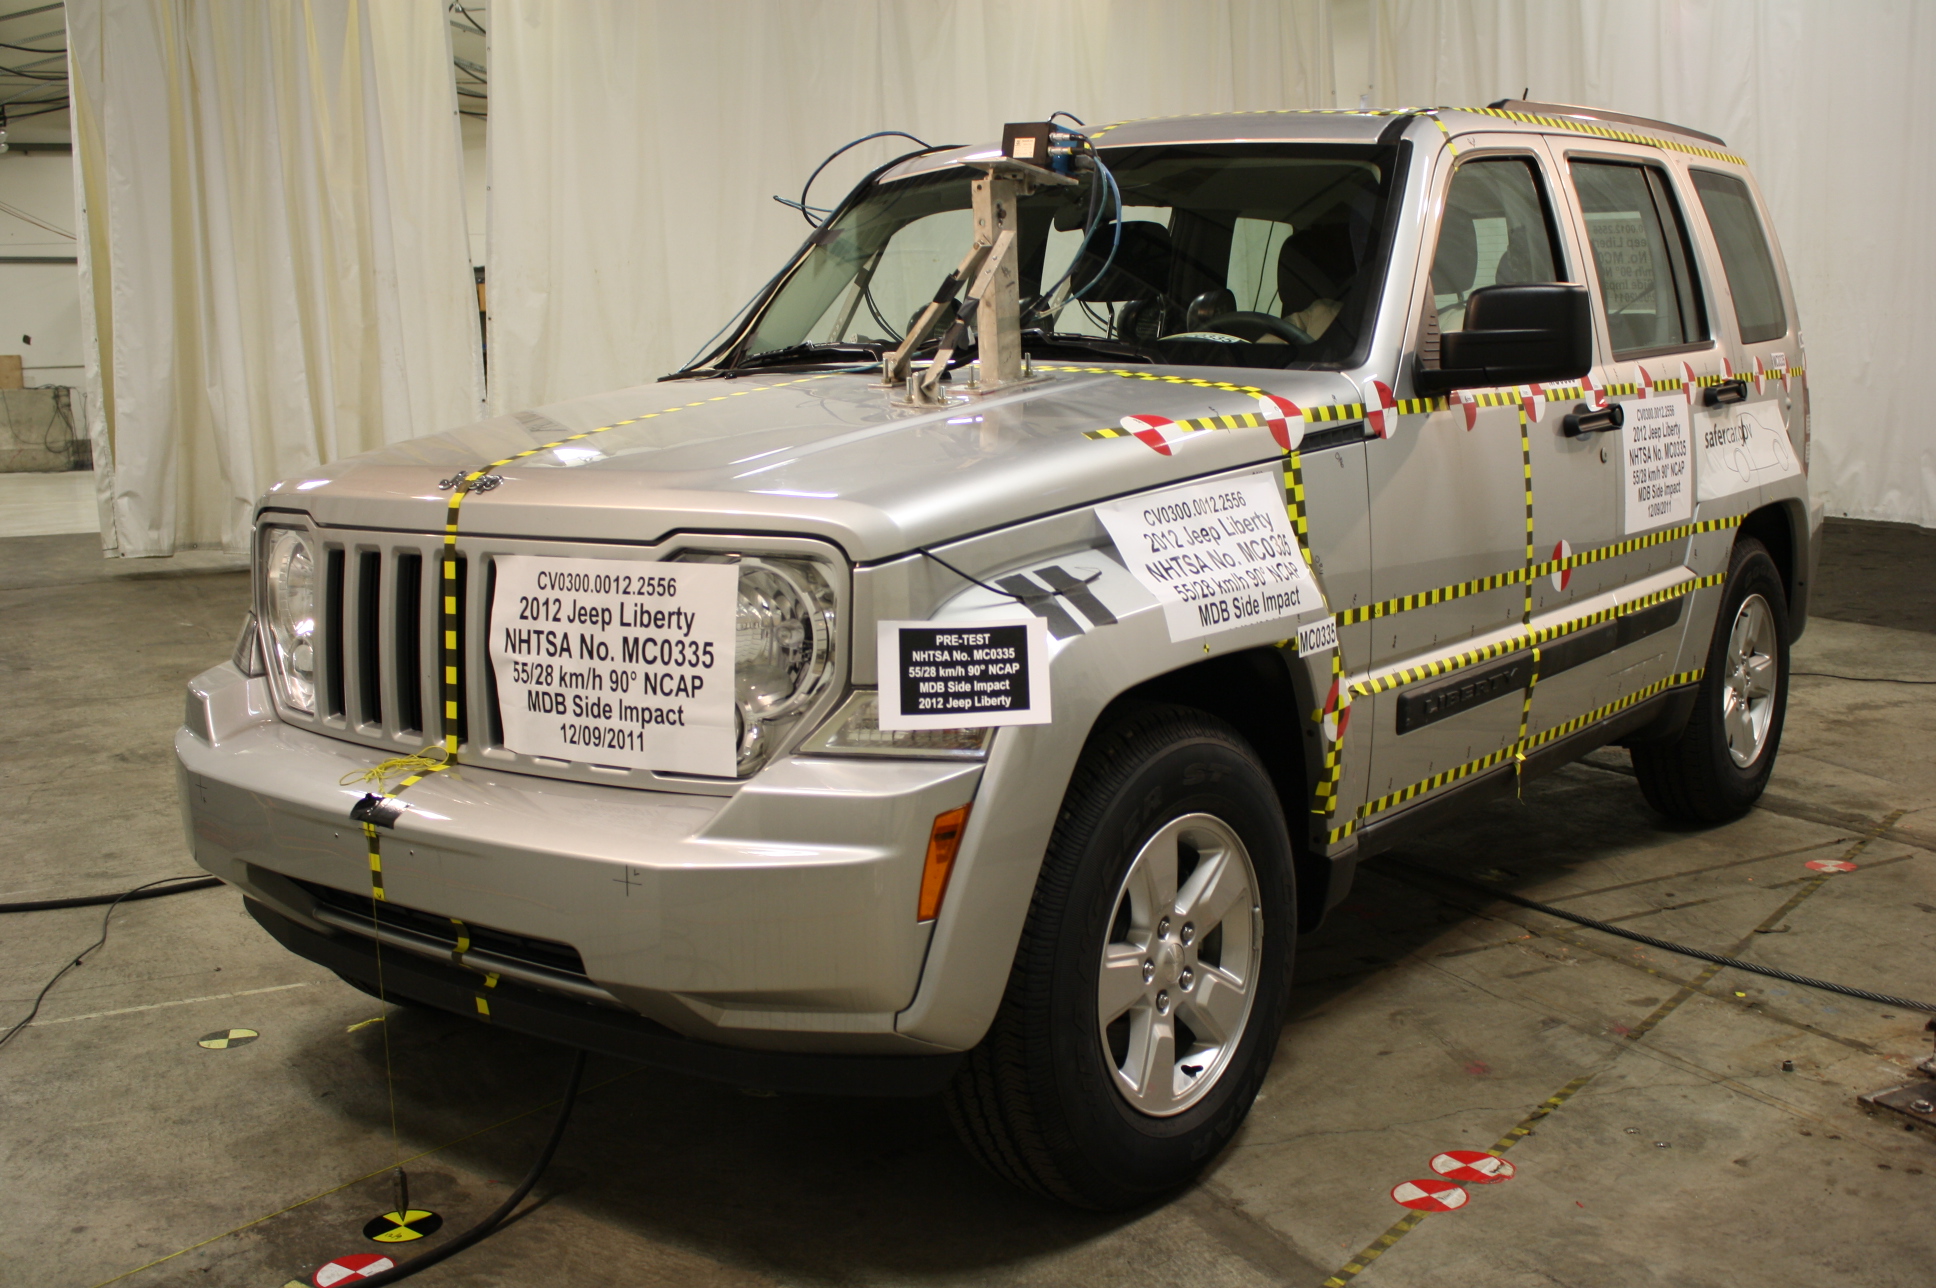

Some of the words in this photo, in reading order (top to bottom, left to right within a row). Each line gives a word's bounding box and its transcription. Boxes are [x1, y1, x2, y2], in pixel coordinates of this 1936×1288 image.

[1636, 404, 1675, 421] CV0300.0012.2556
[1632, 425, 1647, 443] 2012
[1648, 424, 1662, 440] Jeep
[1662, 422, 1681, 440] Liberty
[1629, 448, 1652, 467] NHTSA
[1653, 446, 1664, 462] No.
[1664, 440, 1687, 459] MC0335
[1632, 468, 1647, 485] 55/28
[1647, 465, 1661, 482] km/h
[1661, 463, 1669, 479] 90°
[1670, 460, 1685, 477] NCAP
[1637, 487, 1651, 503] MDB
[1651, 485, 1663, 500] Side
[1663, 481, 1681, 498] Impact
[1143, 490, 1247, 527] CV0300.0012.2556
[1647, 501, 1672, 518] 12/09/2011
[1143, 529, 1184, 553] 2012
[1182, 524, 1221, 546] Jeep
[1217, 510, 1275, 538] Liberty
[1145, 552, 1213, 583] NHTSA
[1206, 548, 1242, 569] No.
[1236, 533, 1292, 564] MC0335
[537, 571, 677, 597] CV0300.0012.2556
[1173, 579, 1216, 603] 55/28
[1211, 573, 1251, 596] km/h
[1248, 566, 1266, 587] 90°
[1268, 561, 1300, 583] NCAP
[519, 596, 562, 623] 2012
[567, 599, 613, 632] Jeep
[619, 602, 695, 637] Liberty
[1198, 600, 1231, 628] MDB
[1233, 595, 1260, 621] Side
[1261, 586, 1301, 615] Impact
[504, 627, 572, 659] NHTSA
[579, 633, 615, 662] No.
[622, 636, 715, 669] MC0335
[935, 633, 991, 646] PRE-TEST
[1299, 622, 1336, 654] MC0335
[912, 650, 951, 662] NHTSA
[952, 649, 971, 661] No.
[973, 648, 1015, 661] MC0335
[512, 661, 554, 686] 55/28
[558, 665, 603, 691] km/h
[609, 669, 637, 694] 90°
[644, 672, 704, 698] NCAP
[908, 666, 937, 678] 55/28
[939, 665, 965, 677] km/h
[967, 664, 986, 676] 90°
[988, 662, 1020, 675] NCAP
[919, 681, 945, 693] MDB
[947, 680, 972, 693] Side
[973, 679, 1010, 693] Impact
[1424, 667, 1518, 714] LIBERTY
[527, 689, 567, 715] MDB
[572, 694, 613, 720] Side
[619, 699, 685, 729] Impact
[918, 697, 944, 709] 2012
[946, 697, 972, 710] Jeep
[974, 695, 1011, 708] Liberty
[560, 723, 645, 752] 12/09/2011
